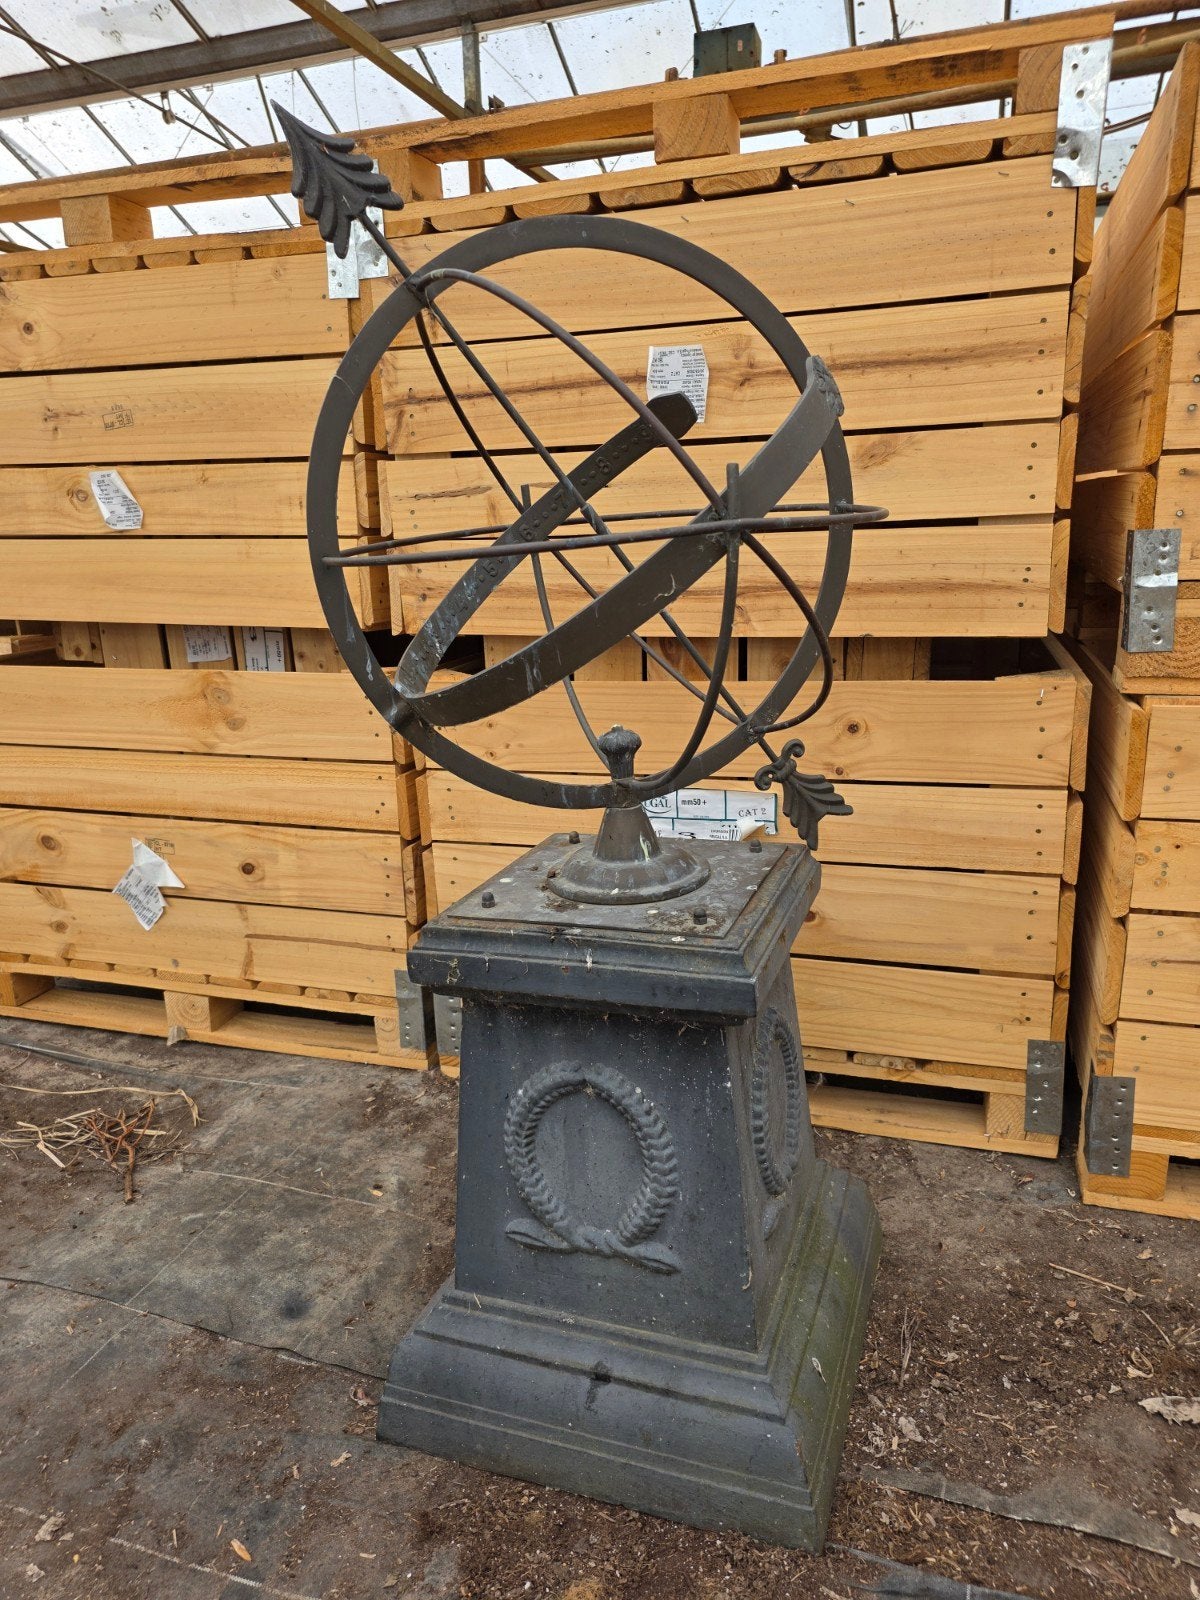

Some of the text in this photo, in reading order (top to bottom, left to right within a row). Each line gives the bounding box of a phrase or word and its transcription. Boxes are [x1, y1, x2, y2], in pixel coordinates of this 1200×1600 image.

[482, 560, 498, 577] 5
[519, 523, 535, 541] 6
[554, 488, 568, 509] 7
[597, 456, 612, 473] 8
[738, 808, 758, 817] CAT
